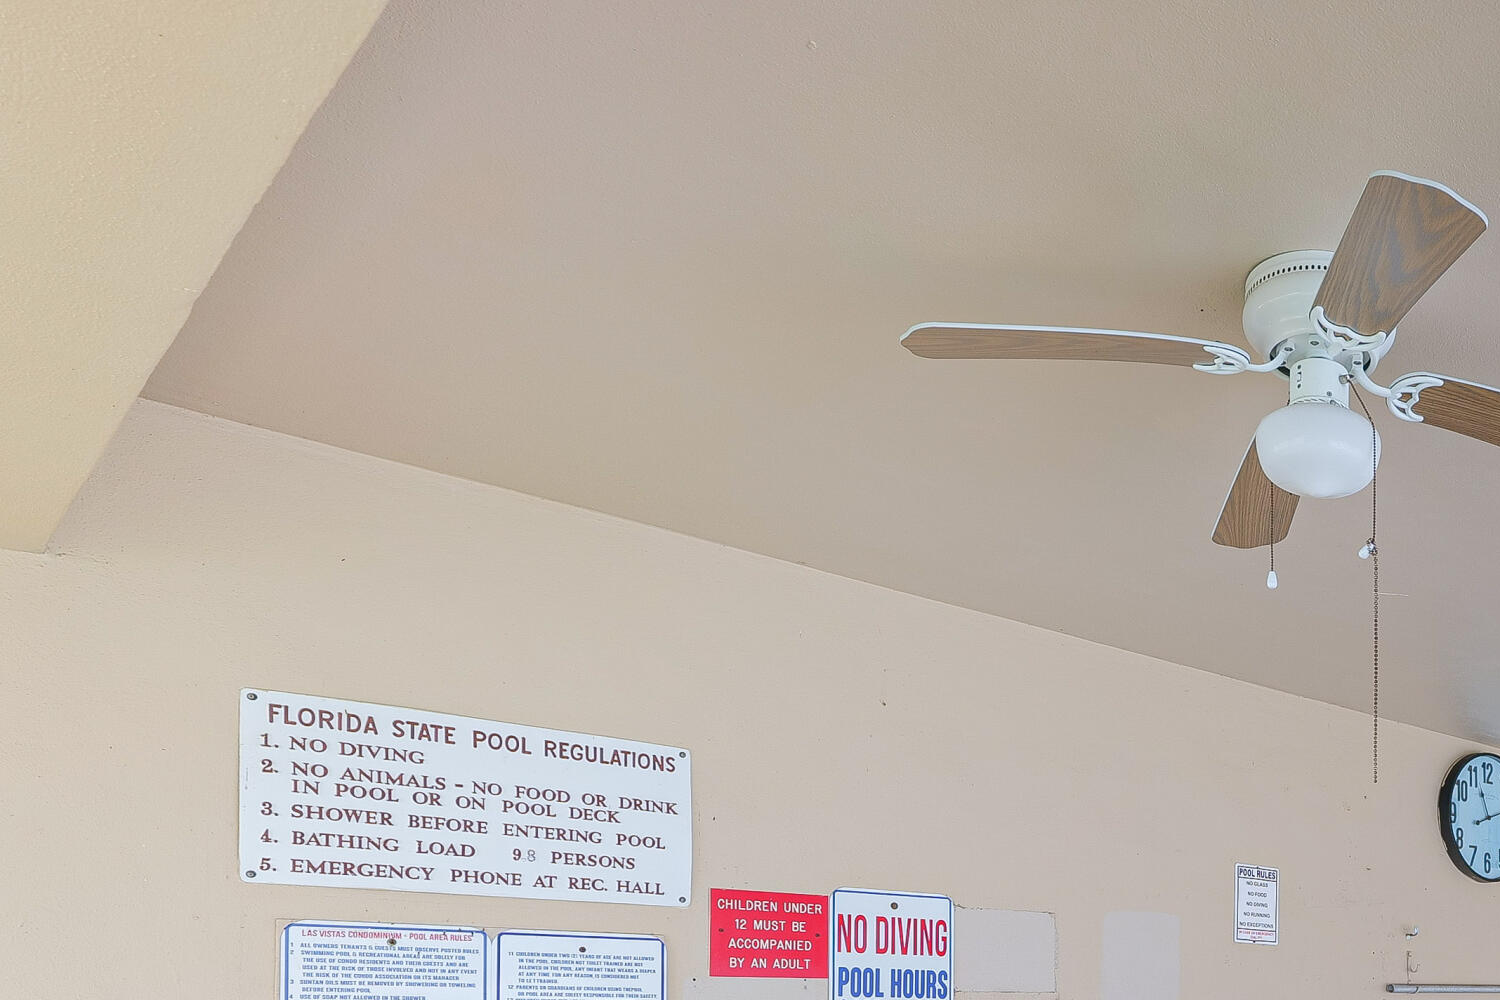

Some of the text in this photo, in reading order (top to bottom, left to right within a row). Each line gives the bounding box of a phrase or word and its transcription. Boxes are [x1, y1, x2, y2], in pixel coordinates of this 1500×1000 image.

[261, 733, 425, 764] 1. NO DIVING
[268, 703, 676, 773] FLORIDA STATE POOL REGULATIONS
[1468, 765, 1478, 788] 11
[1481, 762, 1493, 784] 12
[261, 759, 279, 774] 2.
[291, 761, 328, 778] NO
[340, 766, 446, 791] ANIMALS
[472, 780, 502, 796] NO
[515, 785, 570, 803] FOOD
[582, 792, 607, 808] OR
[618, 796, 678, 815] DRINK
[1456, 780, 1467, 801] 10
[292, 778, 621, 824] IN POOL OR ON POOL DECK
[1451, 802, 1456, 823] 9
[261, 801, 665, 850] 3. SHOWER BEFORE ENTERING POOL
[261, 828, 279, 843] 4.
[292, 830, 399, 852] BATHING
[416, 840, 475, 857] LOAD
[551, 851, 635, 870] PERSONS
[1456, 828, 1463, 849] 8
[1469, 846, 1477, 866] 7
[1484, 853, 1491, 873] 6
[259, 858, 665, 896] 5. EMERGENCY PHONE AT REC. HALL
[1240, 868, 1275, 879] POOL RULES
[717, 898, 822, 914] CHILDREN UNDER
[320, 930, 345, 938] VISTAS
[735, 919, 806, 932] 12 MUST BE
[837, 914, 947, 957] NO DIVING
[728, 938, 812, 951] ACCOMPANIED
[729, 957, 811, 970] BY AN ADULT
[838, 967, 947, 999] POOL HOURS
